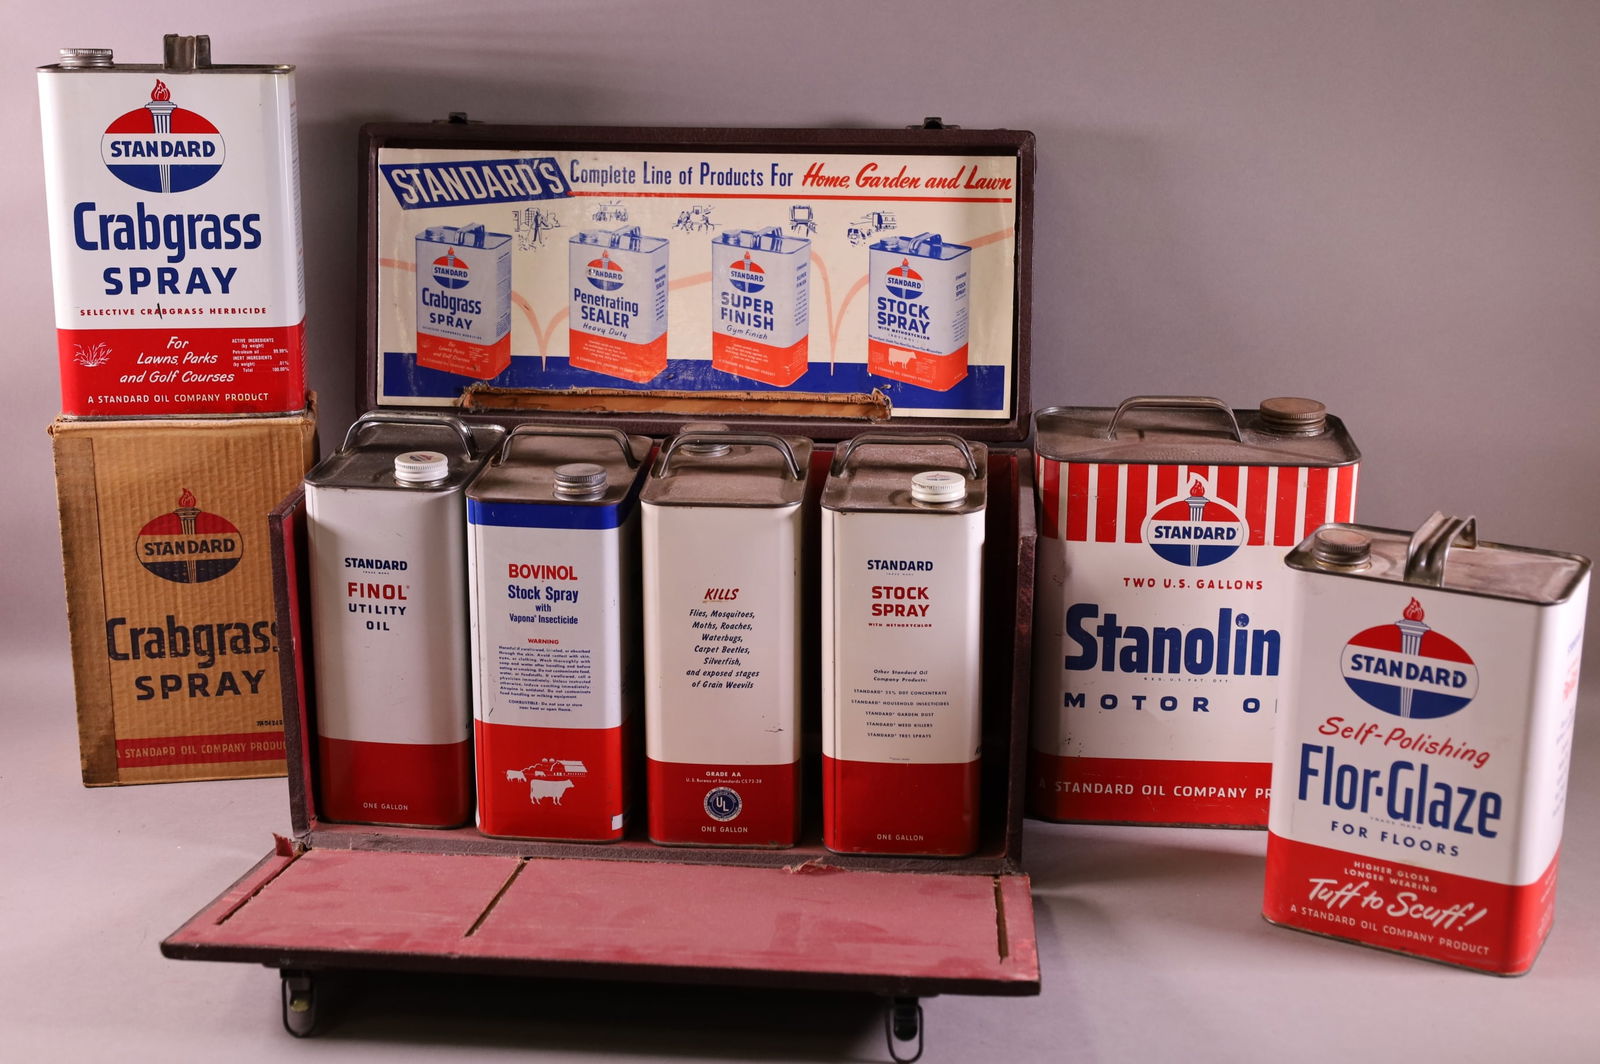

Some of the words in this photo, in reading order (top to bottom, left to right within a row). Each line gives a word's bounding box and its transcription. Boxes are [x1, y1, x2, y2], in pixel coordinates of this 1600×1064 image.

[110, 140, 216, 158] STANDARD
[390, 158, 564, 205] STANDARD'S
[570, 159, 636, 187] Complete
[643, 161, 671, 185] Line
[679, 167, 693, 185] of
[700, 162, 764, 186] Products
[771, 163, 793, 187] For
[801, 162, 850, 189] Home,
[855, 162, 920, 189] Garden
[924, 167, 961, 189] and
[963, 165, 1012, 190] Lawn
[73, 201, 262, 264] Crabgrass
[433, 266, 468, 279] STANDARD
[730, 270, 763, 283] STANDARD
[102, 266, 237, 296] SPRAY
[887, 277, 921, 290] STANDARD
[422, 287, 482, 316] Crabgrass
[574, 287, 639, 317] Penetrating
[721, 292, 774, 315] SUPER
[877, 296, 930, 319] STOCK
[80, 308, 135, 316] SELECTIVE
[141, 307, 204, 316] CRABGRASS
[209, 306, 267, 315] HERBICIDE
[581, 305, 629, 329] SEALER
[429, 312, 472, 330] SPRAY
[721, 308, 774, 331] FINISH
[877, 312, 930, 334] SPRAY
[583, 322, 606, 336] Heavy
[608, 328, 628, 340] Duty
[727, 324, 743, 335] Gym
[167, 336, 189, 350] For
[137, 352, 179, 365] Lawns,
[182, 351, 218, 365] Parks
[120, 372, 147, 384] and
[149, 370, 178, 385] Golf
[181, 371, 235, 384] Courses
[88, 396, 94, 404] A
[98, 394, 150, 404] STANDARD
[154, 394, 170, 403] OIL
[174, 393, 220, 402] COMPANY
[225, 392, 269, 402] PRODUCT
[1154, 525, 1237, 540] STANDARD
[144, 539, 235, 556] STANDARD
[345, 557, 408, 571] STANDARD
[509, 564, 578, 580] BOVINOL
[867, 559, 934, 571] STANDARD
[348, 582, 407, 600] FINOL
[1124, 577, 1156, 588] TWO
[1163, 579, 1190, 589] U.S.
[1196, 579, 1263, 590] GALLONS
[508, 585, 541, 600] Stock
[545, 586, 579, 603] Spray
[704, 588, 739, 600] KILLS
[871, 586, 929, 600] STOCK
[349, 603, 406, 615] UTILITY
[535, 604, 551, 612] with
[689, 609, 708, 618] Flies,
[710, 610, 755, 619] Mosquitoes,
[871, 603, 930, 617] SPRAY
[366, 621, 390, 631] OIL
[538, 615, 578, 624] Insecticide
[692, 622, 718, 631] Moths,
[720, 622, 753, 631] Roaches,
[702, 634, 743, 644] Waterbugs,
[1065, 602, 1281, 676] Stanolin
[694, 645, 719, 654] Carpet
[721, 646, 750, 655] Beetles,
[704, 657, 741, 666] Silverfish,
[702, 670, 733, 678] exposed
[735, 671, 760, 679] stages
[1351, 653, 1467, 688] STANDARD
[135, 670, 266, 701] SPRAY
[726, 681, 754, 689] Weevils
[1064, 693, 1209, 712] MOTOR
[1242, 697, 1277, 713] O
[125, 747, 175, 759] STANDARD
[180, 745, 197, 756] OIL
[201, 742, 246, 754] COMPANY
[1318, 716, 1490, 769] Self-Polishing
[1055, 781, 1134, 795] STANDARD
[1142, 784, 1165, 796] OIL
[1173, 786, 1247, 798] COMPANY
[363, 802, 377, 810] ONE
[380, 803, 408, 811] GALLON
[715, 796, 729, 812] UL
[1331, 821, 1368, 838] FOR
[1380, 830, 1460, 857] FLOORS
[1354, 860, 1393, 874] HIGHER
[1397, 871, 1430, 881] GLOSS
[1344, 868, 1384, 882] LONGER
[1390, 878, 1437, 893] WEARING
[1308, 878, 1361, 909] Tuff
[1361, 888, 1384, 909] to
[1386, 891, 1488, 932] Scuff!
[1290, 904, 1297, 912] A
[1301, 907, 1356, 926] STANDARD
[1361, 920, 1378, 931] OIL
[1383, 924, 1434, 944] COMPANY
[1439, 937, 1489, 955] PRODUCT
